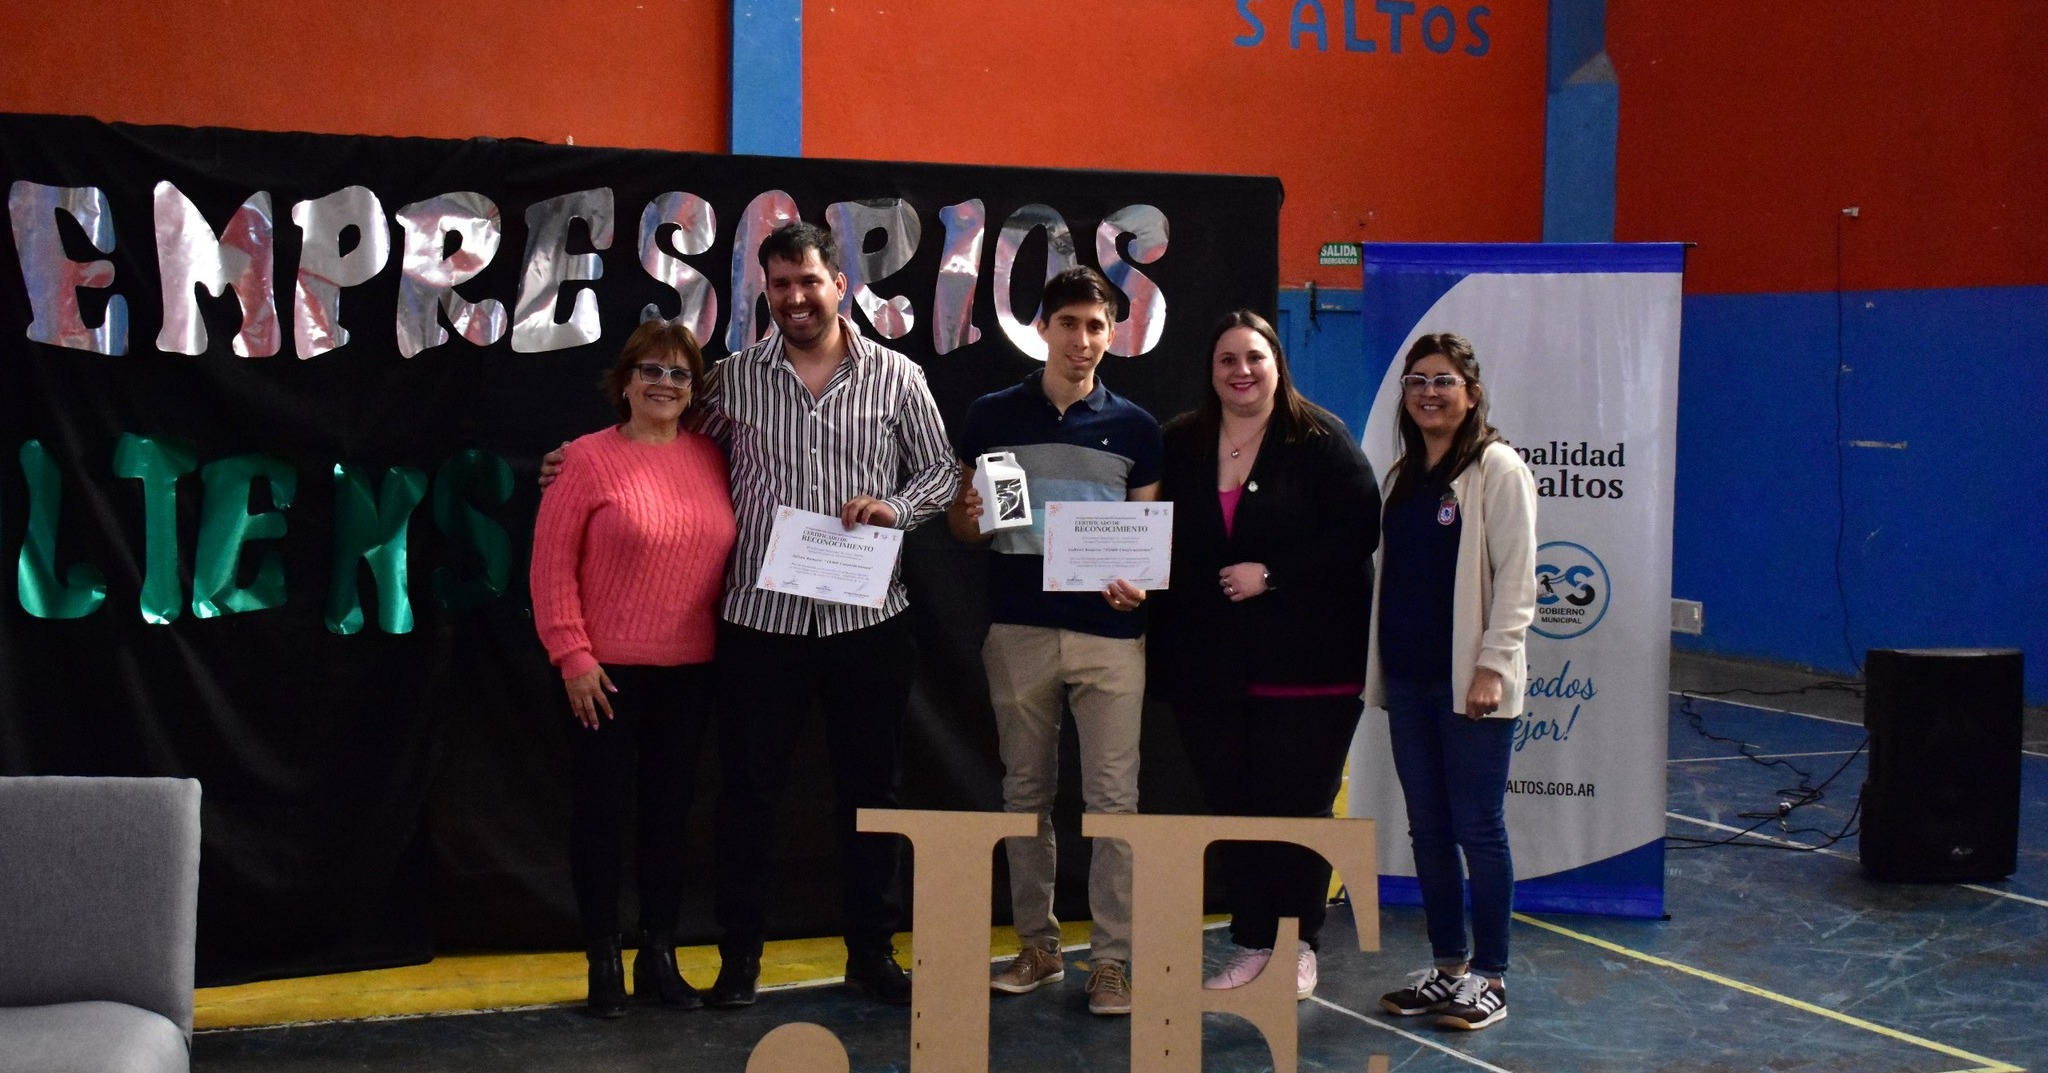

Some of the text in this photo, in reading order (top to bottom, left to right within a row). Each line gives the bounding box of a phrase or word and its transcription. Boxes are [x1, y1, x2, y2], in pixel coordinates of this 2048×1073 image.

[1233, 0, 1491, 57] SALTOS
[1321, 245, 1357, 257] SALIDA
[9, 180, 1169, 361] EMPRESARIOS
[1506, 440, 1626, 468] palidad
[1532, 469, 1624, 500] altos
[17, 431, 516, 635] LTENS
[1074, 525, 1148, 533] RECONOCIMIENTO
[801, 534, 874, 553] RECONOCIMIENTO
[1539, 607, 1585, 616] GOBIERNO
[1541, 617, 1582, 625] MUNICIPAL
[1505, 780, 1595, 797] ALTOS.GOB.AR
